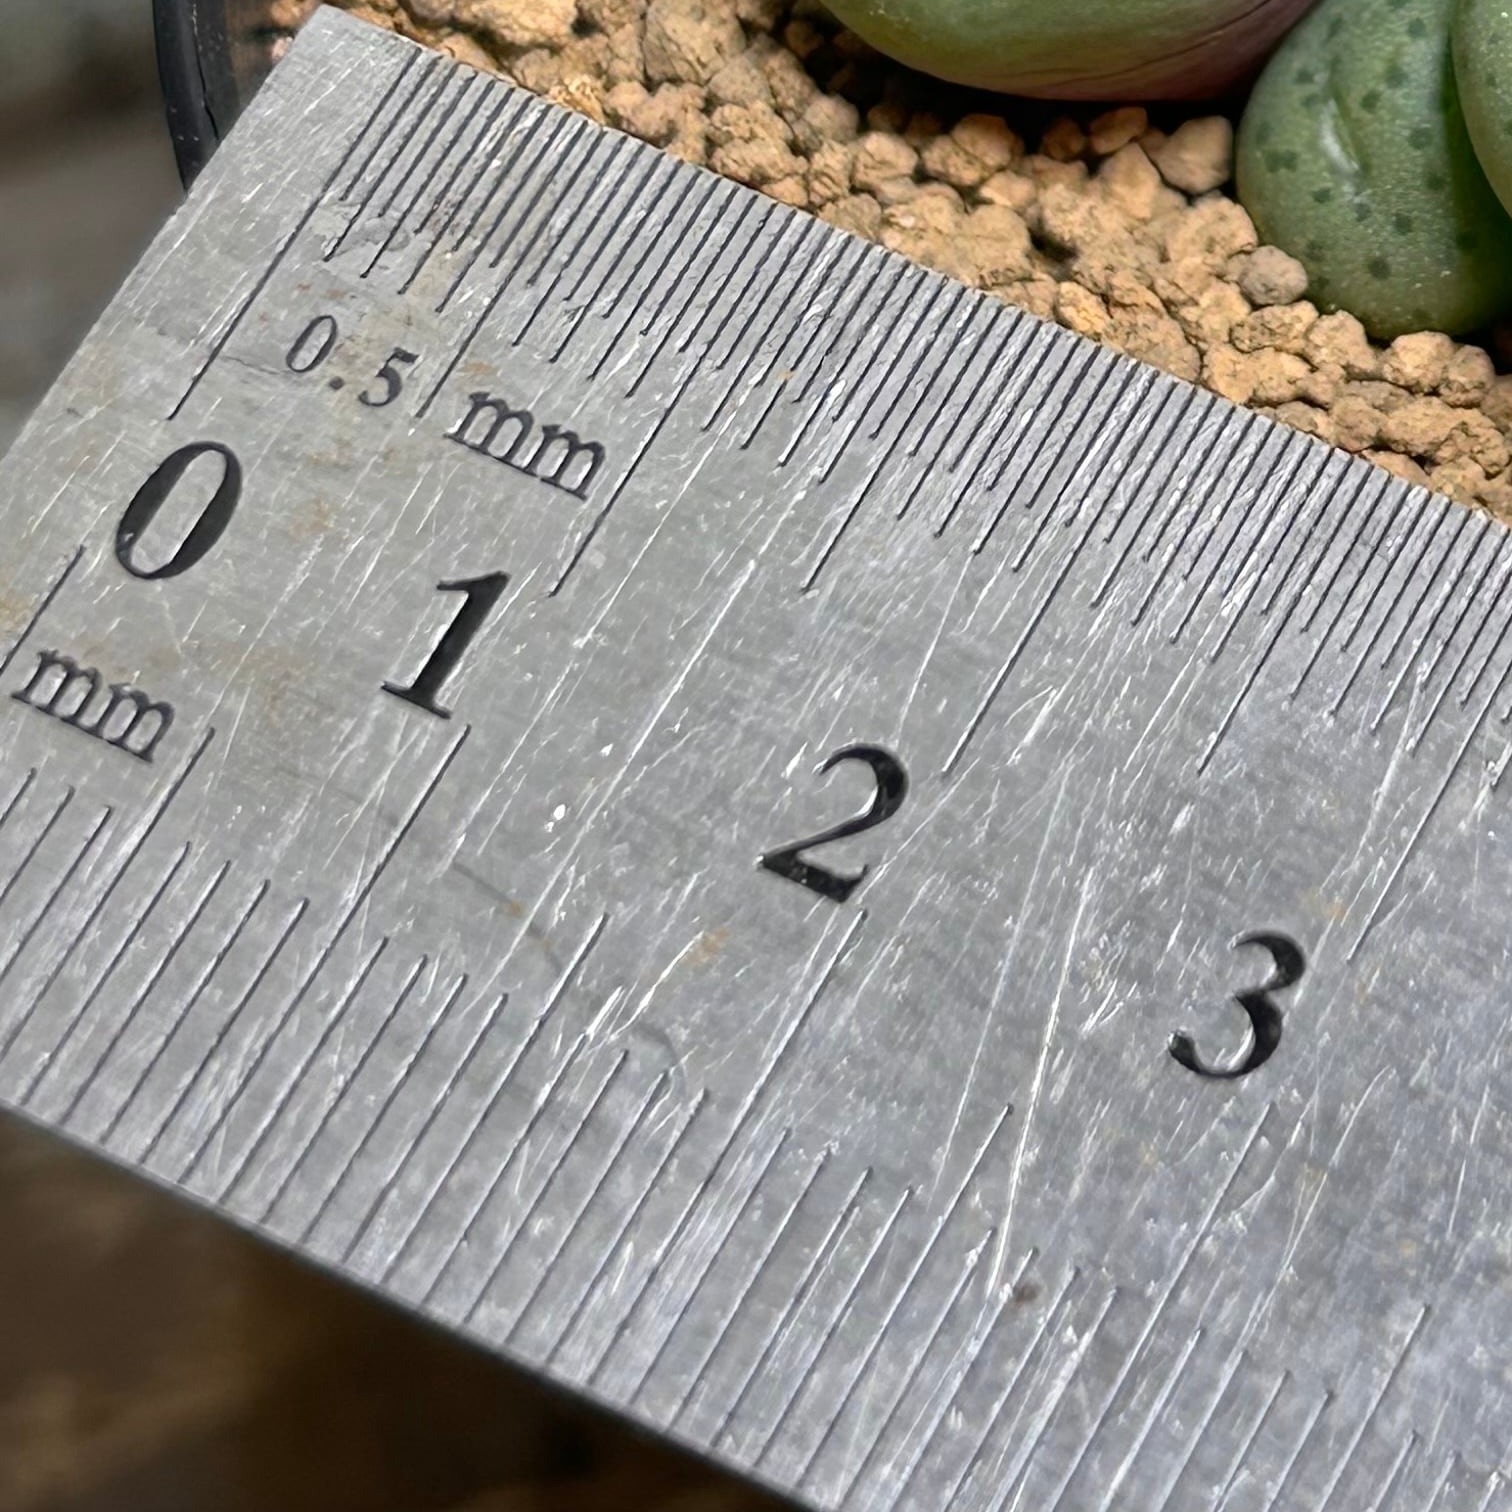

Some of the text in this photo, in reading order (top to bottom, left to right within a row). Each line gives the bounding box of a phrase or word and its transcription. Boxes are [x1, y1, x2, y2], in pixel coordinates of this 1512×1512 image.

[284, 314, 606, 500] 0.5 mm
[14, 646, 176, 764] mm
[114, 440, 243, 581] 0
[380, 569, 509, 720] 1
[756, 742, 910, 904] 2
[1167, 929, 1307, 1080] 3
